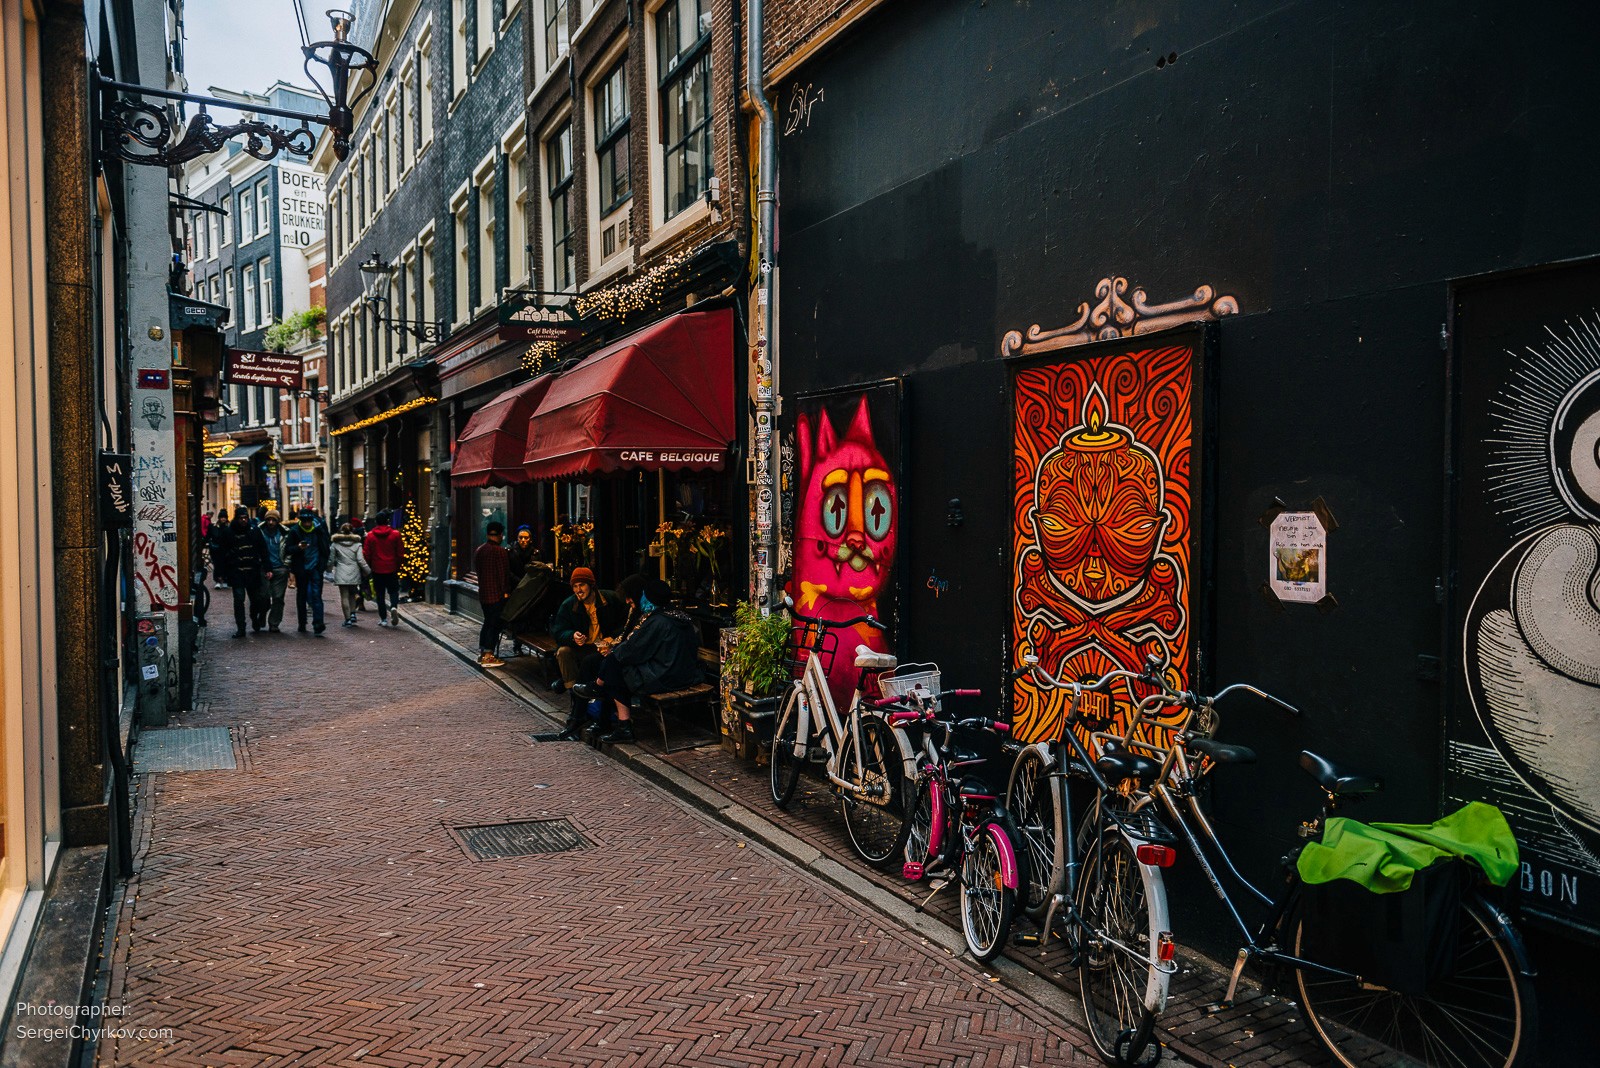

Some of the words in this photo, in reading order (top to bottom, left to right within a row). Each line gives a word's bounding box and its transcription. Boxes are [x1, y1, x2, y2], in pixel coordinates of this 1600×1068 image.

[294, 190, 307, 198] en
[282, 198, 325, 216] STEEN
[542, 328, 567, 336] Belgique
[620, 451, 653, 461] CAFE
[660, 452, 720, 462] BELGIQUE
